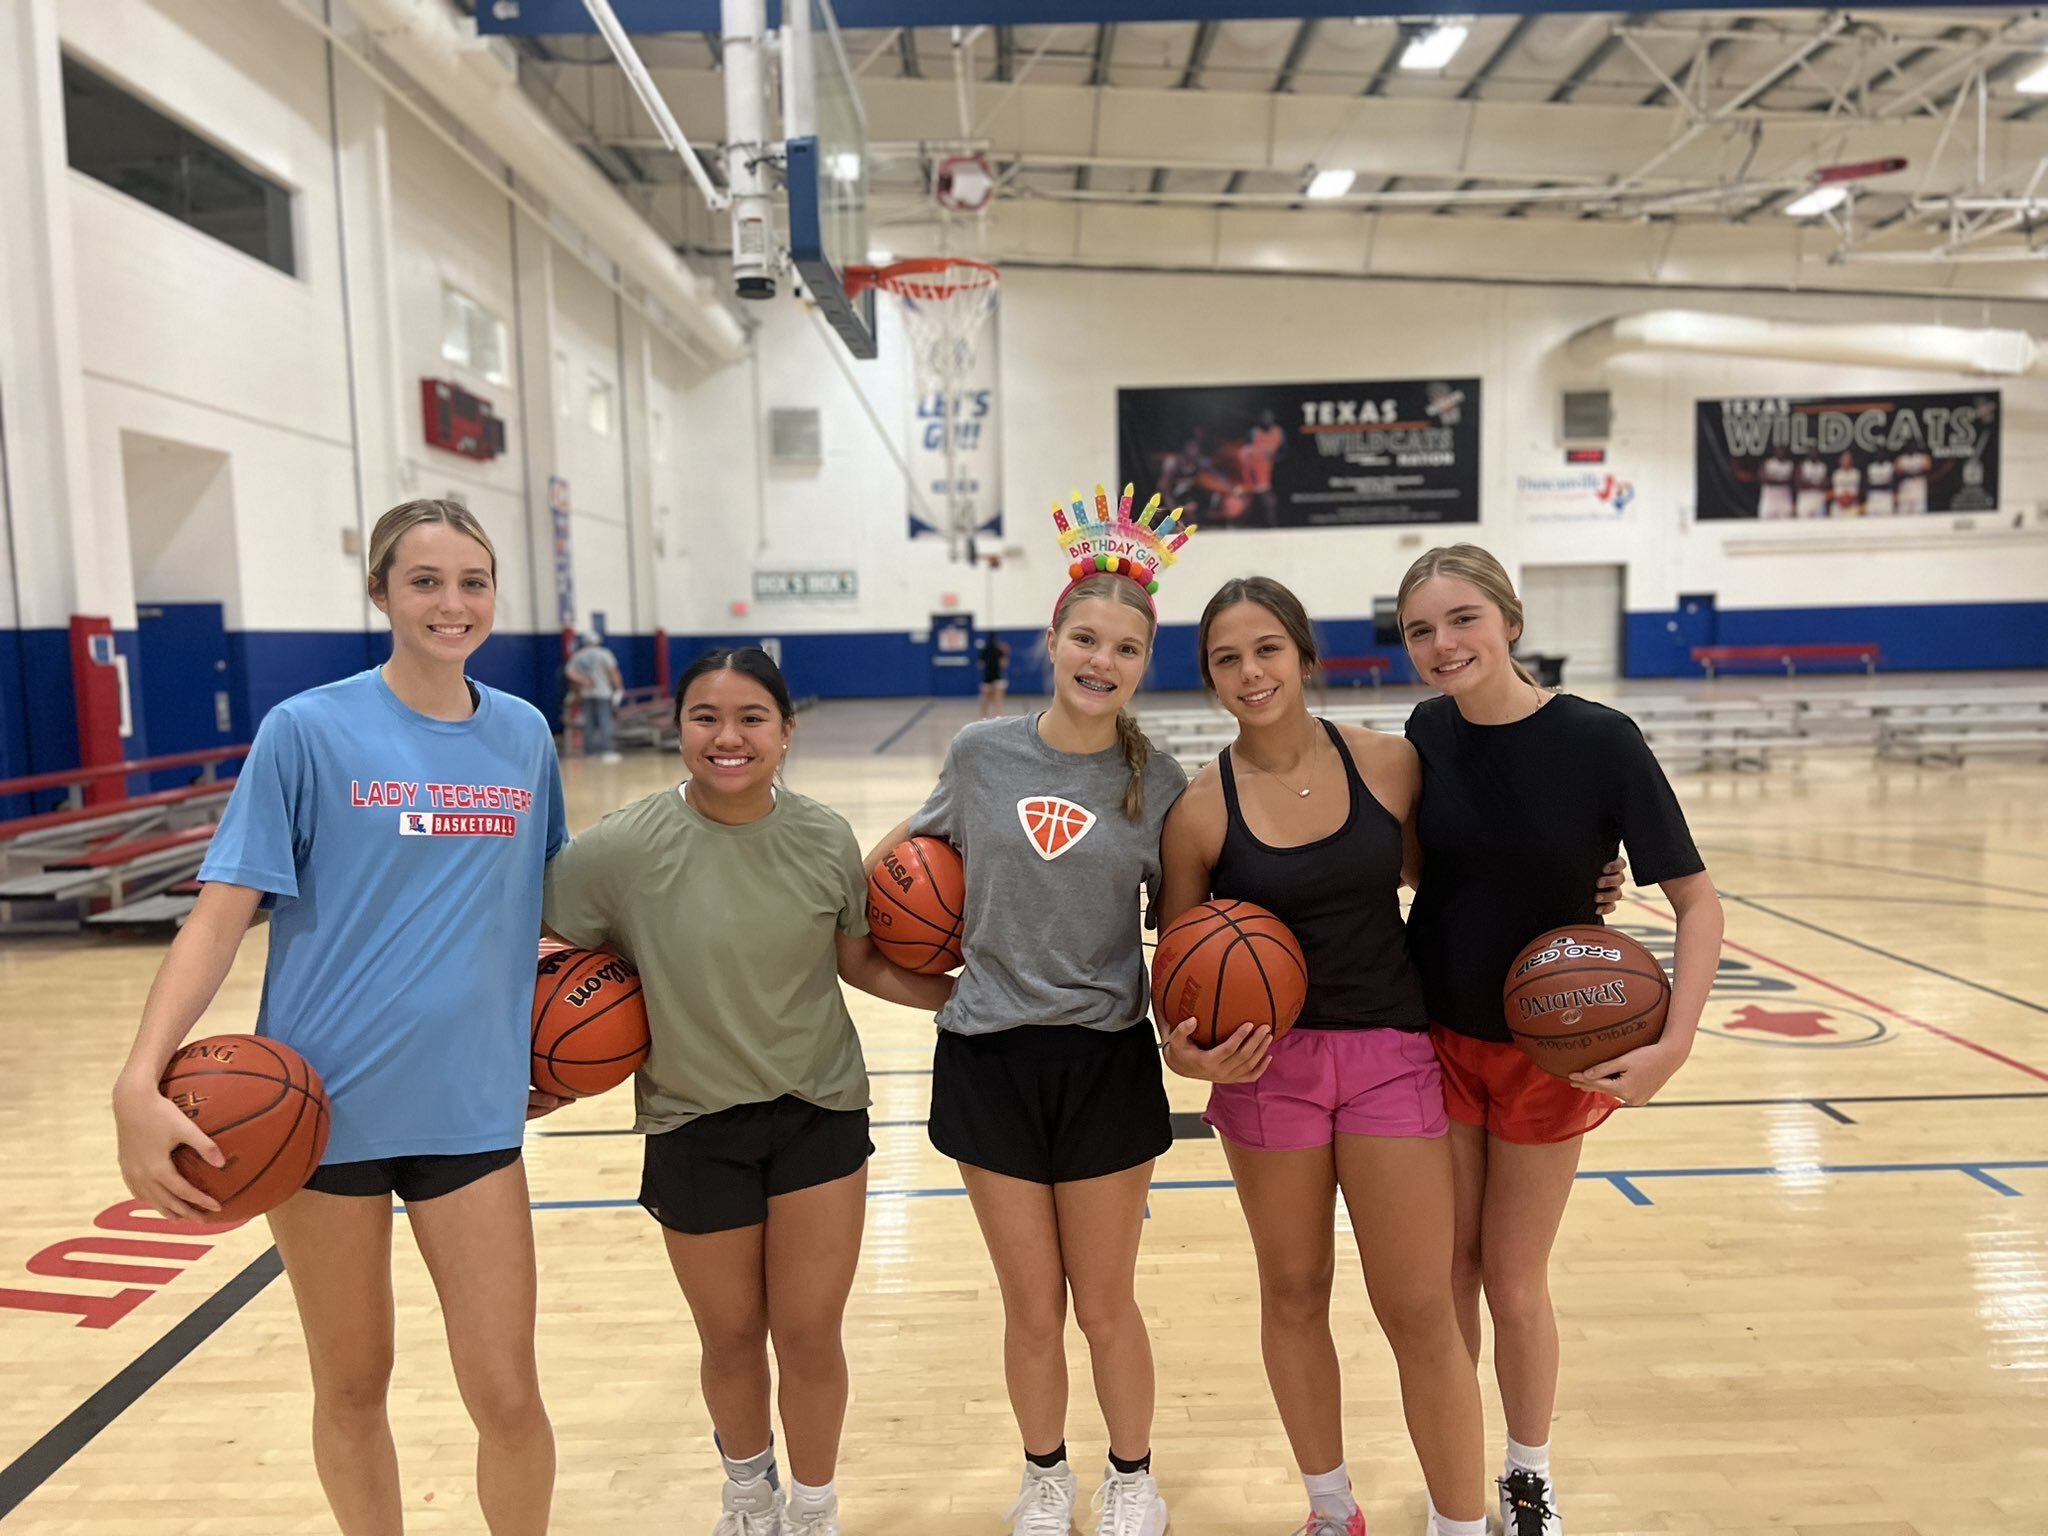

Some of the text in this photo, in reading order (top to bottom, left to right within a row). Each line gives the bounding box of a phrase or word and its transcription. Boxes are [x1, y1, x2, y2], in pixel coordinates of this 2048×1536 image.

[1301, 399, 1398, 425] TEXAS
[1315, 428, 1454, 456] WILDCATS
[1722, 407, 1977, 456] WILDCATS
[1069, 540, 1160, 574] BIRTHDAY GIRL
[352, 781, 419, 807] LADY
[434, 817, 513, 833] BASKETBALL
[1515, 945, 1622, 979] PRO GRIP
[1519, 979, 1627, 1023] SPALDING
